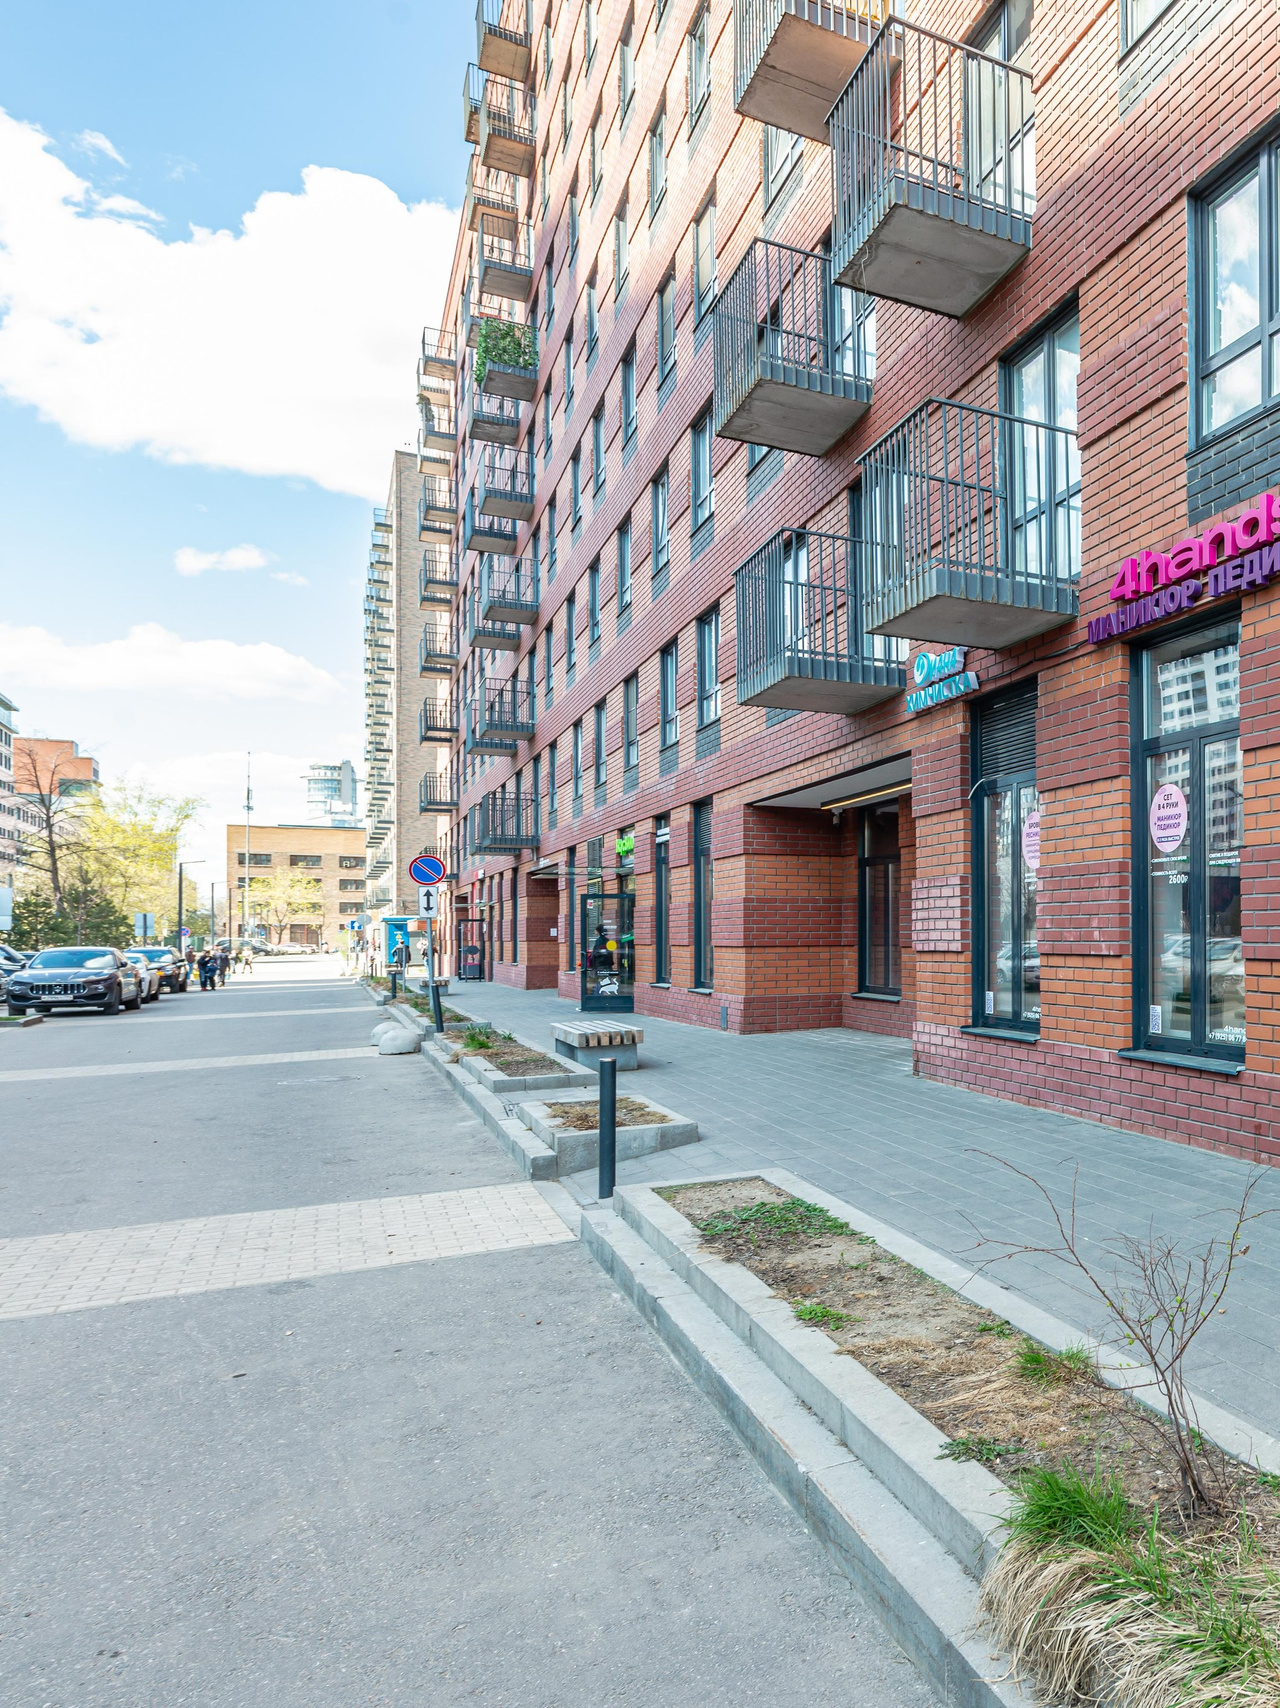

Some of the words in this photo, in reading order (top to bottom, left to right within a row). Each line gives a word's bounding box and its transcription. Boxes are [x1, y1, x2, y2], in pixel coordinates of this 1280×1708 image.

[1087, 578, 1203, 645] МАНИКЮР
[905, 671, 978, 714] ХИМЧИСТКА
[1163, 793, 1173, 802] СЕТ
[1166, 801, 1179, 810] РУКИ
[1157, 813, 1182, 823] МАНИКЮР
[1157, 822, 1181, 831] ПЕДИКЮР
